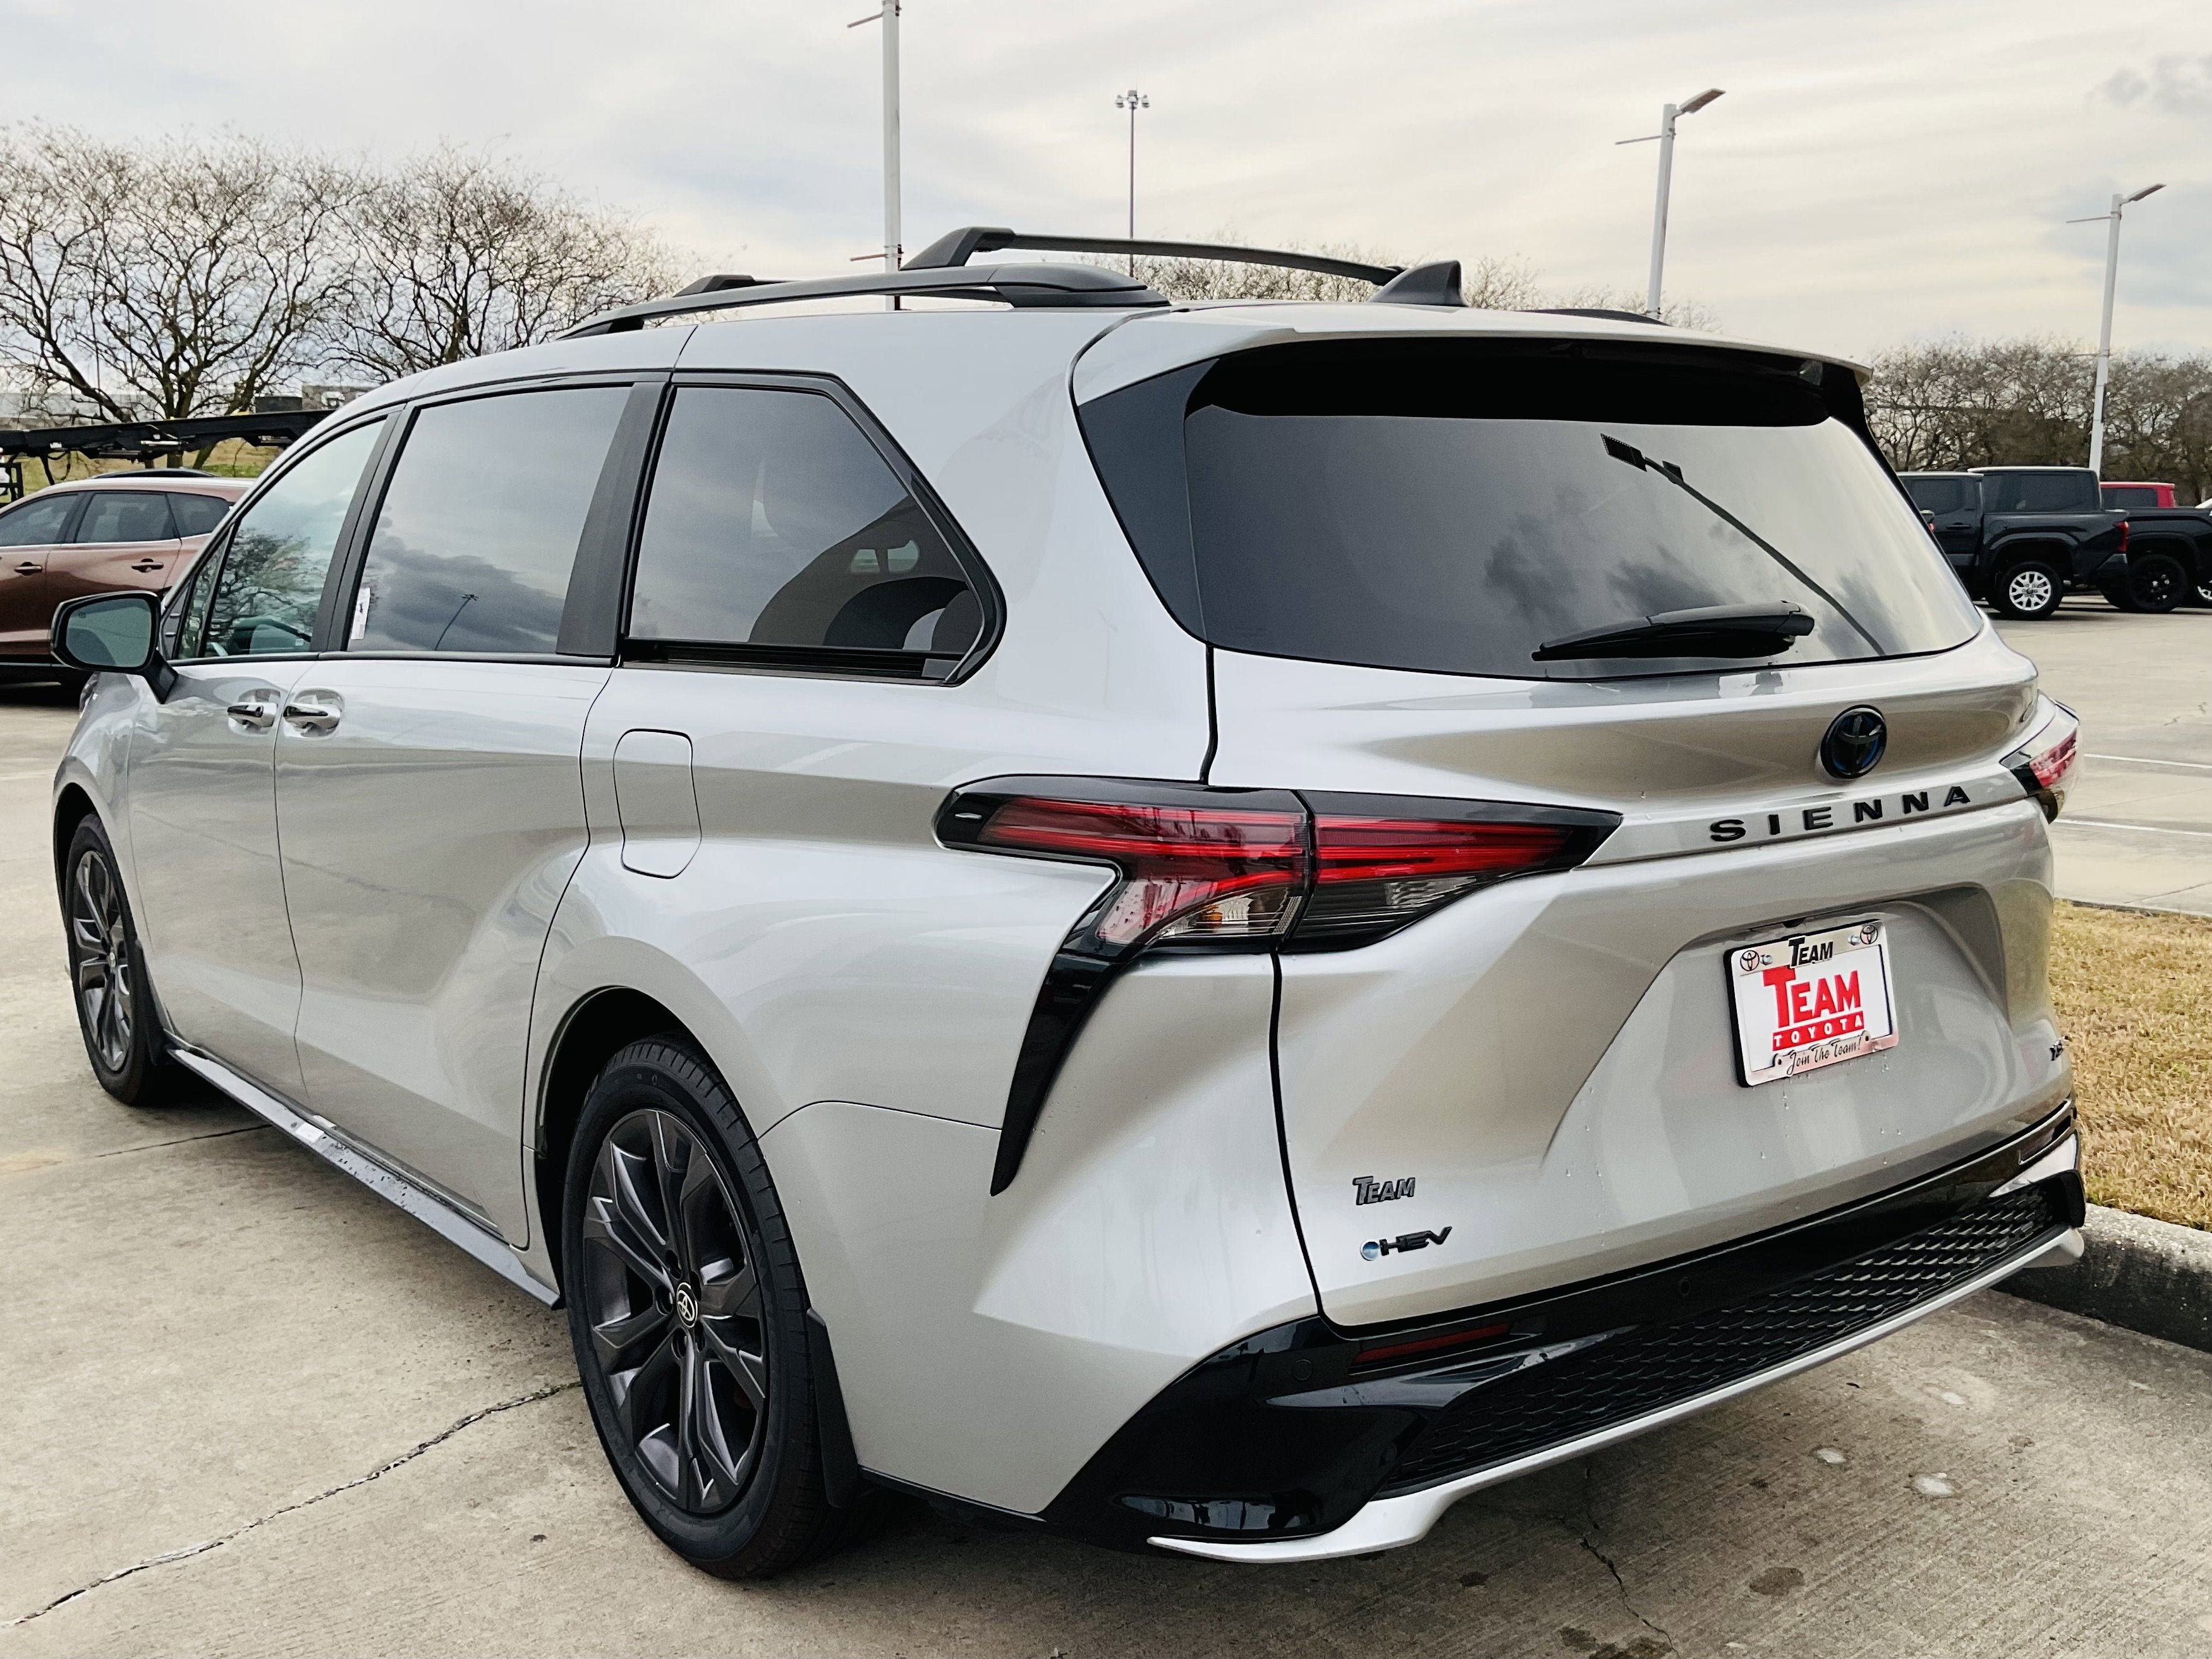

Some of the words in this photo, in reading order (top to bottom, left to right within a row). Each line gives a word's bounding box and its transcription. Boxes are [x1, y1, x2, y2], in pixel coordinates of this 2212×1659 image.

[1710, 786, 1971, 841] SIENNA
[1788, 937, 1833, 967] TEAM
[1763, 964, 1861, 1028] TEAM
[1773, 1014, 1863, 1047] TOYOTA
[1787, 1052, 1809, 1075] Join
[1352, 1176, 1416, 1205] TEAM
[1379, 1226, 1452, 1256] HEV
